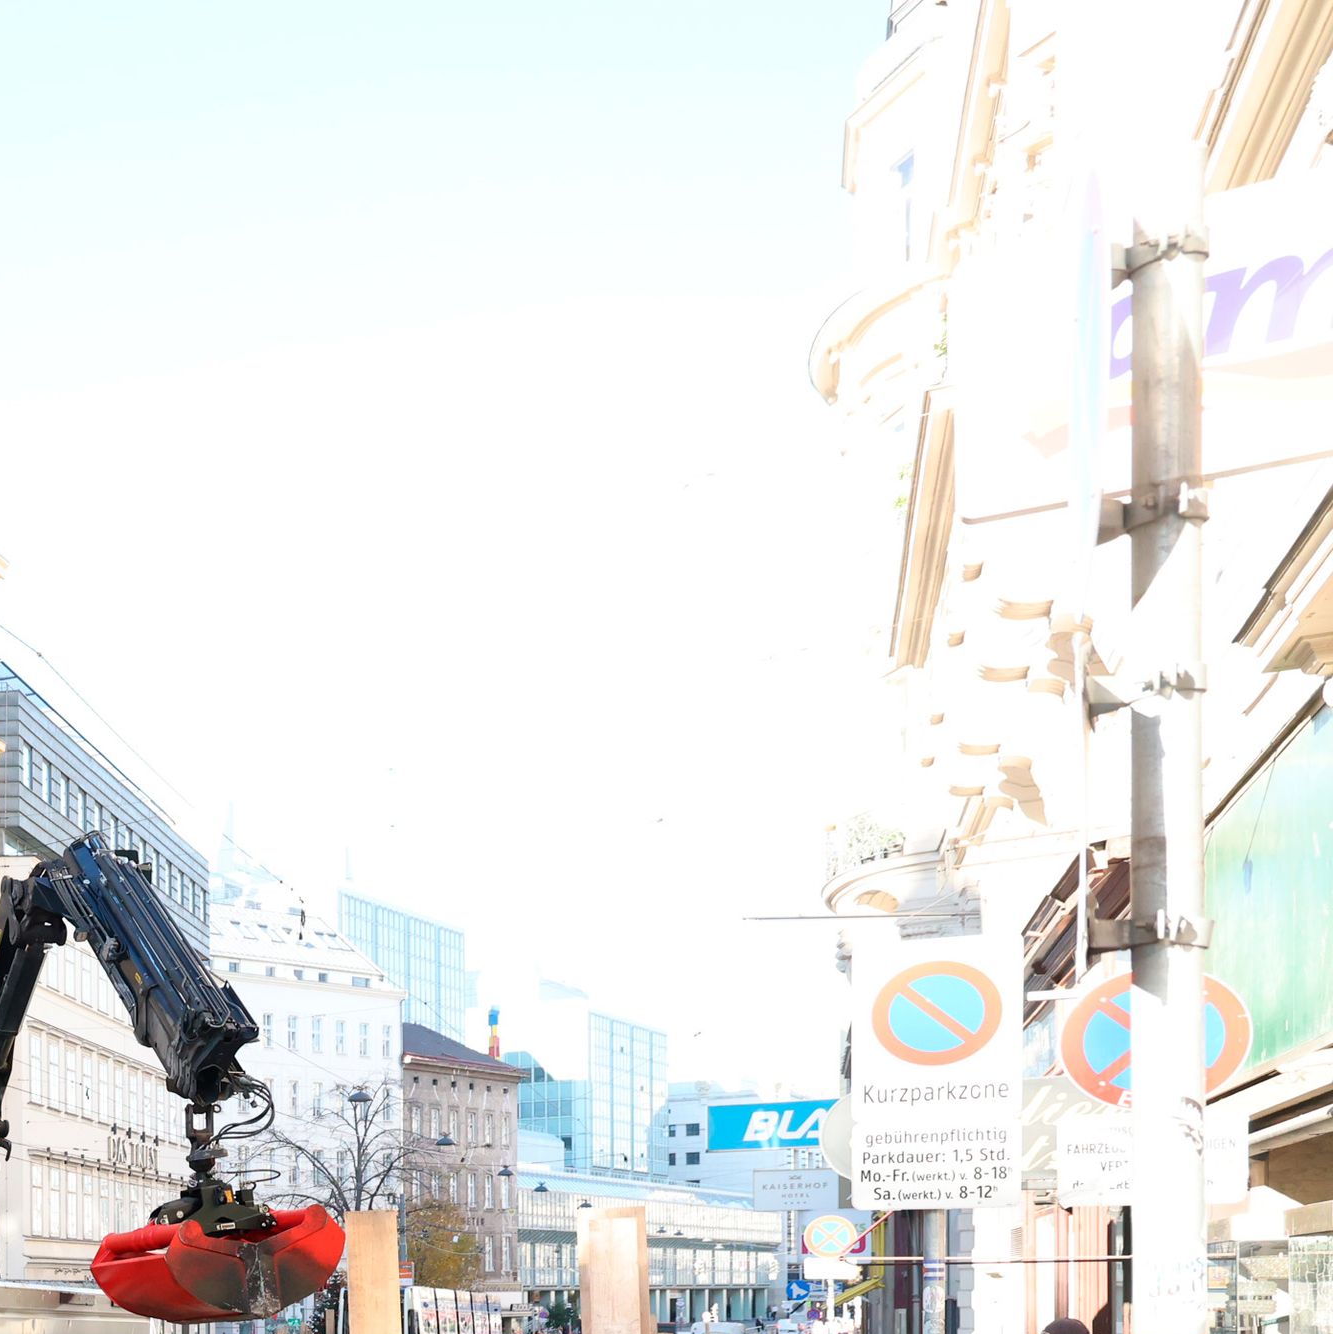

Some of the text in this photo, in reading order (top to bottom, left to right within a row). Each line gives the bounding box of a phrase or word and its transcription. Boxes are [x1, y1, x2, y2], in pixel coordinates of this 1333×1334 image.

[863, 1082, 1009, 1106] Kurzparkzone
[865, 1127, 1007, 1148] gebührenpflichtig
[862, 1148, 1011, 1165] Parkdauer: 1,5 Std.
[959, 1173, 968, 1181] v.
[762, 1182, 829, 1191] KAISERHOF
[945, 1191, 954, 1200] v.
